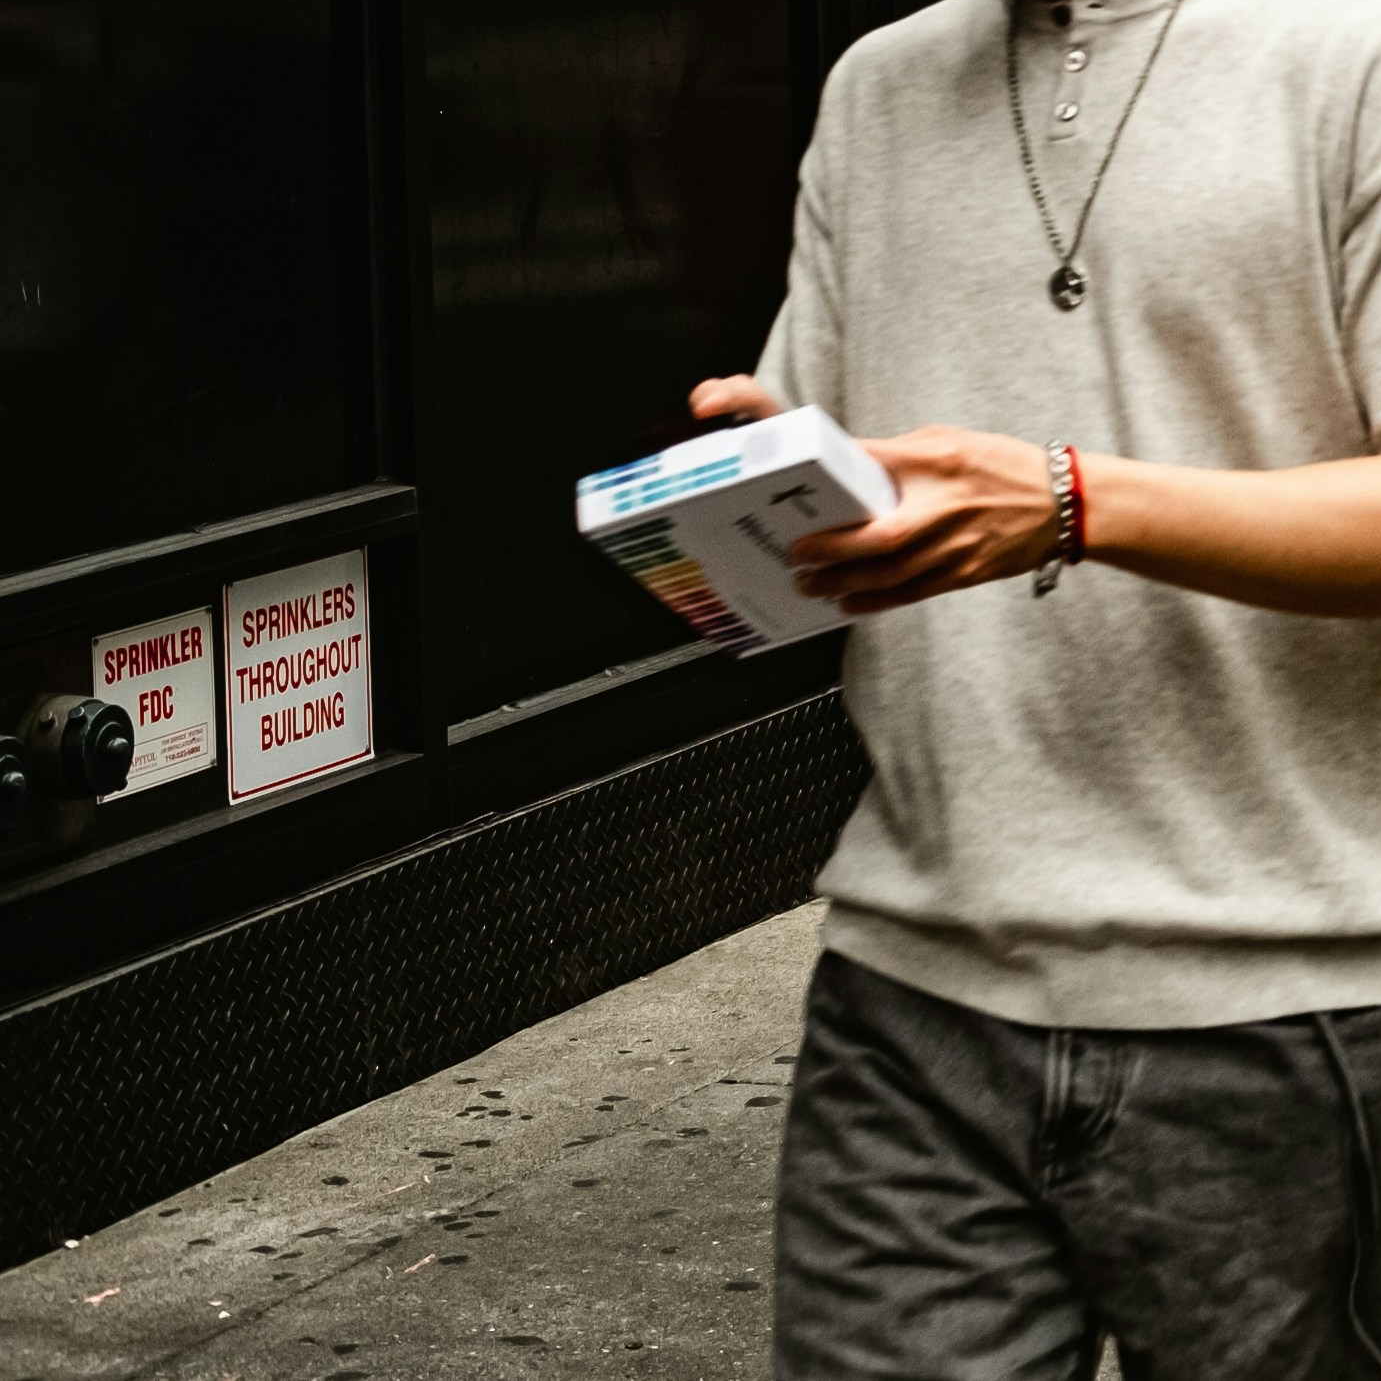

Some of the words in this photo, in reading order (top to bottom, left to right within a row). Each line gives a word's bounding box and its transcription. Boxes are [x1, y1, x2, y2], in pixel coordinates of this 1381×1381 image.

[242, 582, 356, 649] SPRINKLERS
[104, 626, 203, 685] SPRINKLER
[236, 633, 362, 705] THROUGHOUT
[138, 685, 174, 728] FDC
[260, 691, 345, 752] BUILDING
